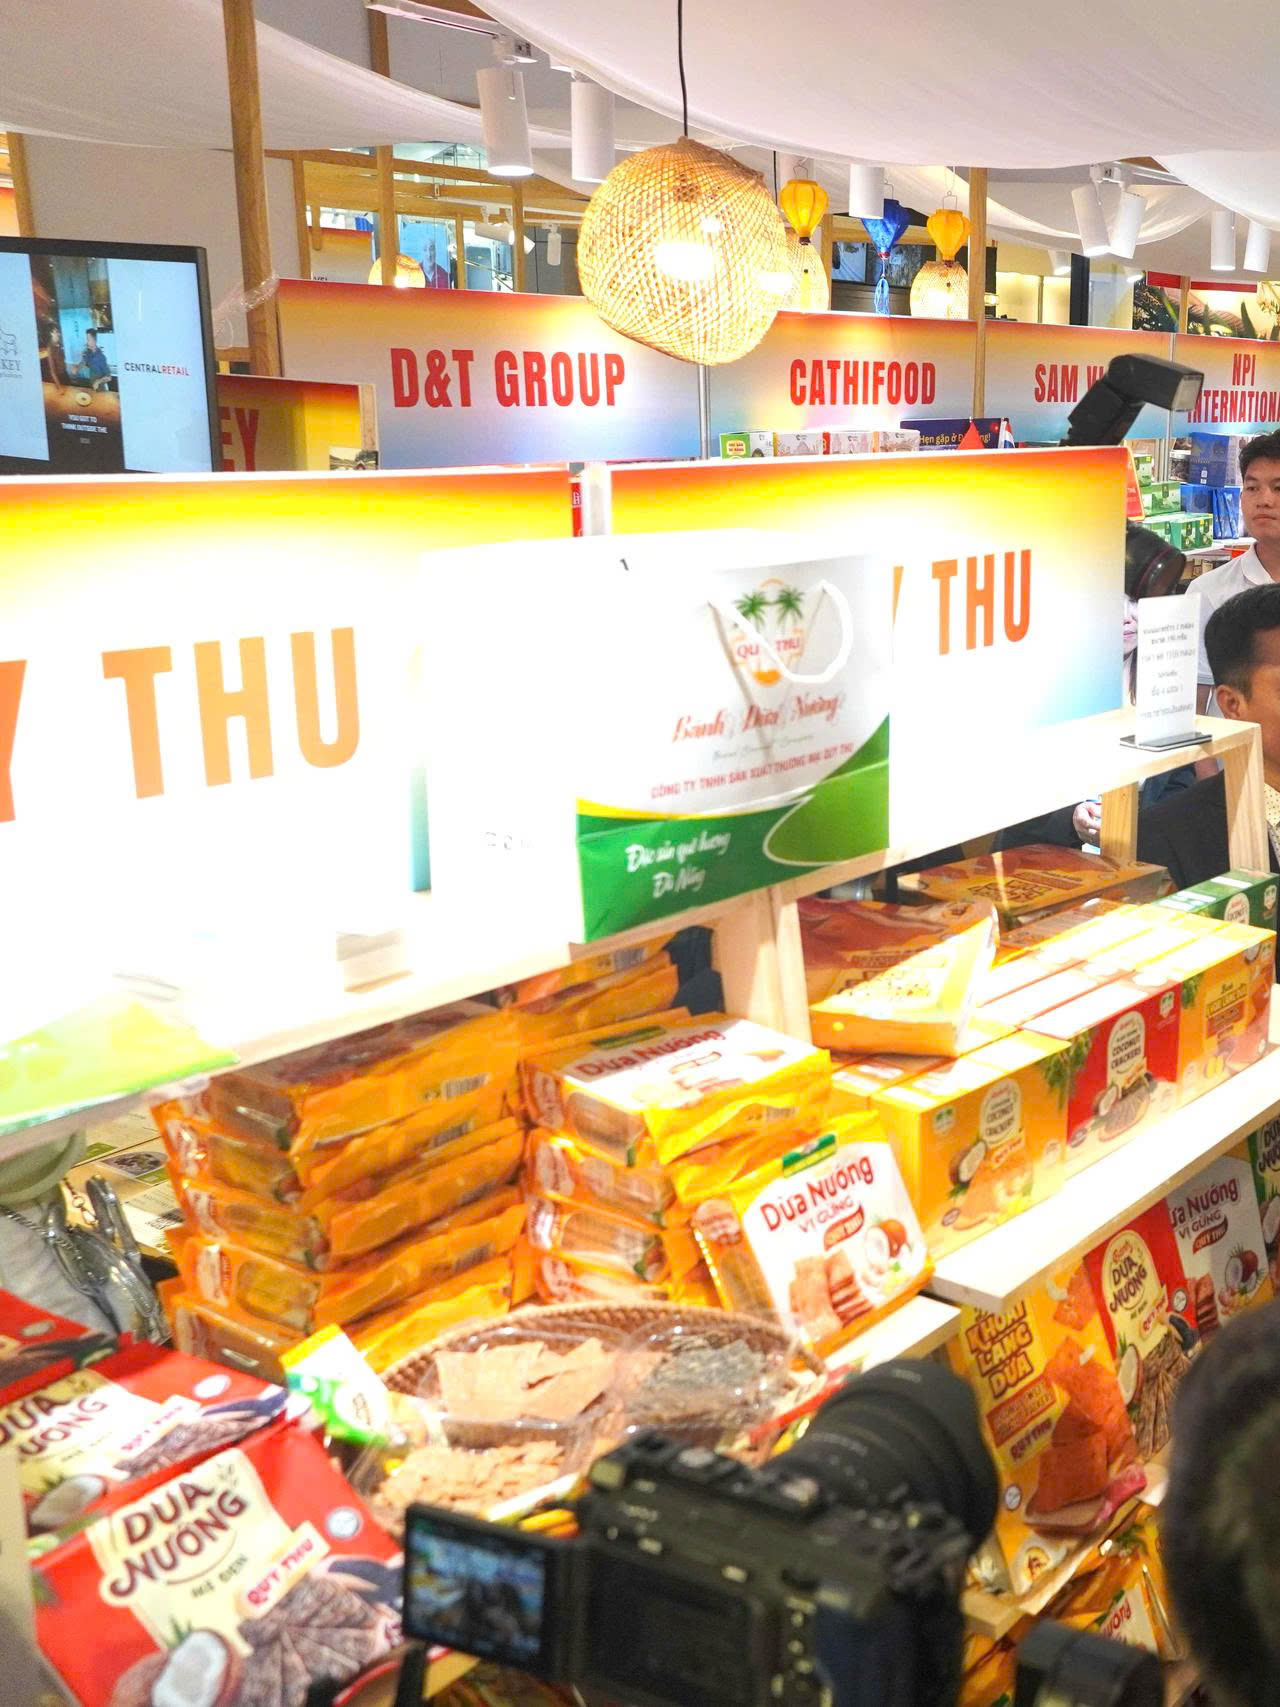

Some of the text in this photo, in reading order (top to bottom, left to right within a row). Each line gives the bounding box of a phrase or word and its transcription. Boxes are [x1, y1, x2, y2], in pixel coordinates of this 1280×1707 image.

[391, 348, 625, 408] D&T GROUP
[790, 358, 936, 406] CATHIFOOD
[1034, 364, 1079, 403] SAM
[1232, 353, 1256, 386] NPI
[931, 549, 1031, 656] THU
[101, 627, 360, 799] THU
